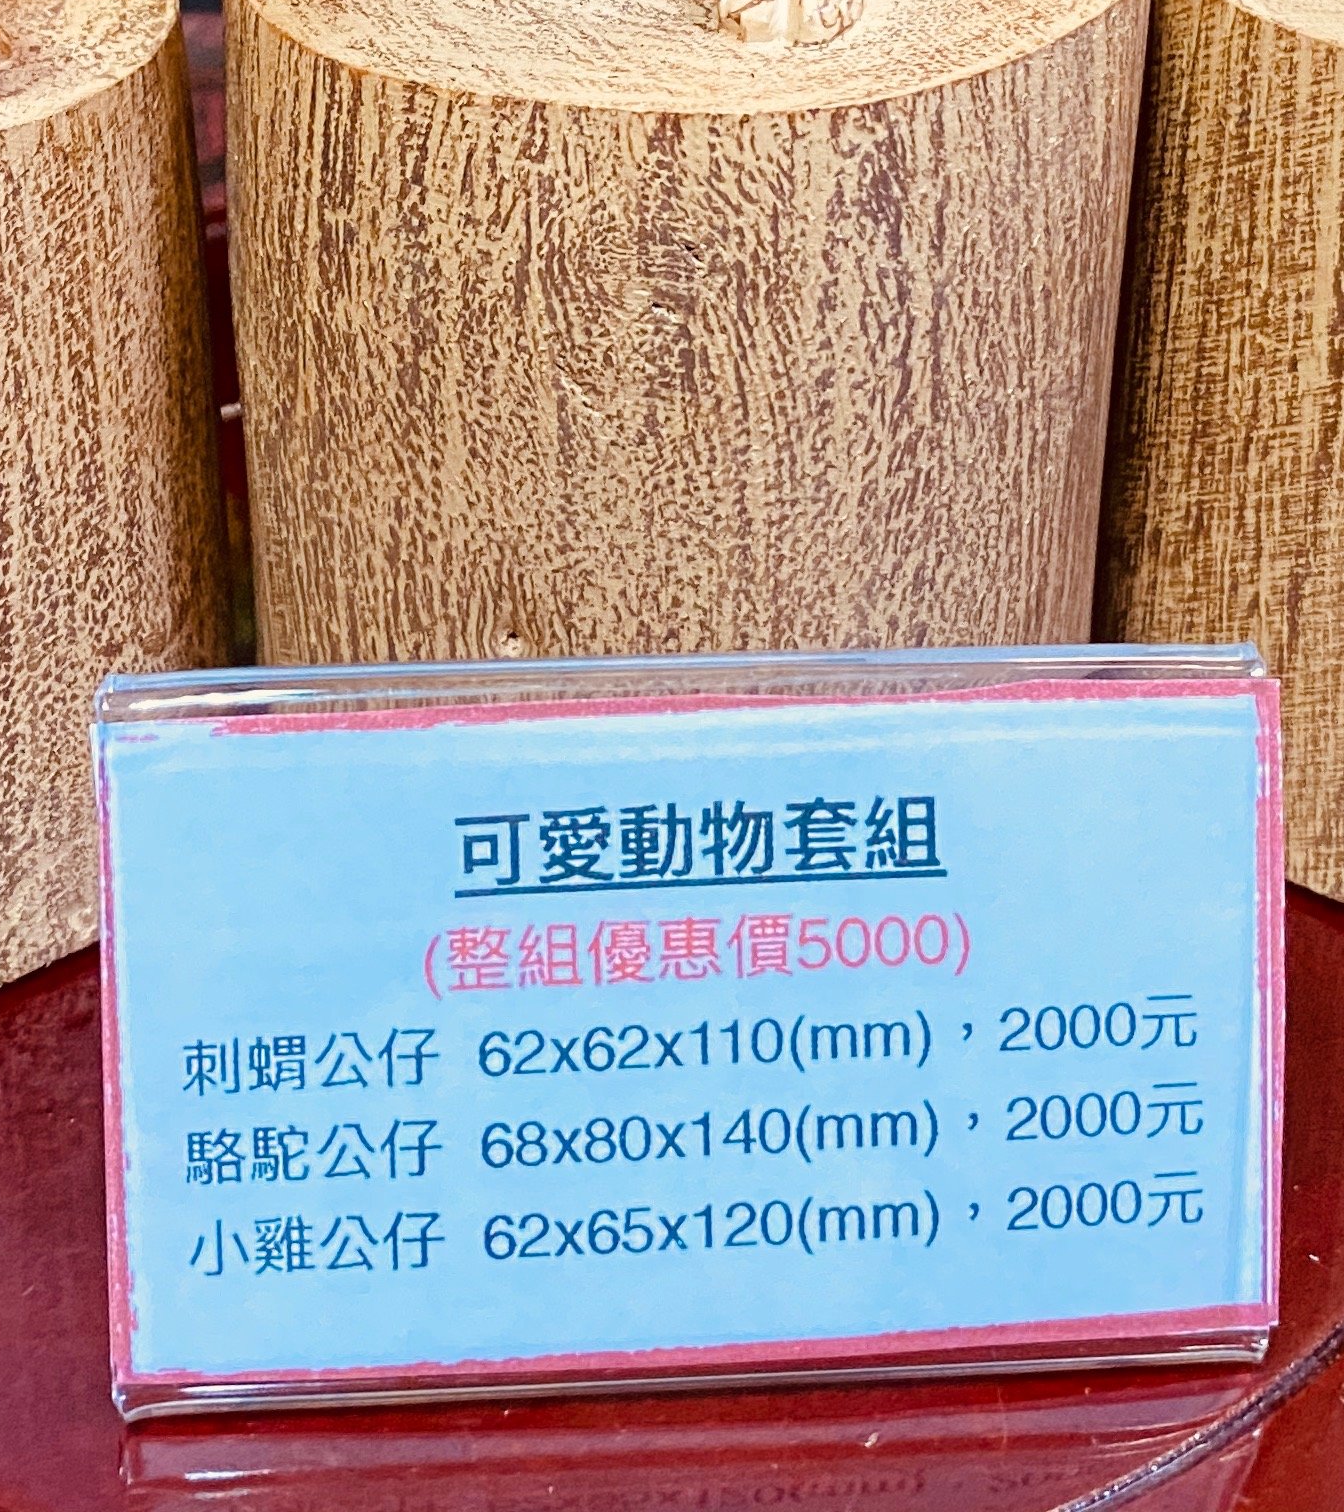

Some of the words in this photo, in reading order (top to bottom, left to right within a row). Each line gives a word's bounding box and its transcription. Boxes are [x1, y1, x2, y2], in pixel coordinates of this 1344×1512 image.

[454, 795, 943, 887] 可愛動物套組
[423, 912, 971, 1001] (整組優惠價5000)
[181, 1026, 440, 1097] 刺蝟公仔
[185, 1118, 442, 1186] 駱駝公仔
[188, 1211, 446, 1277] 小雞公仔
